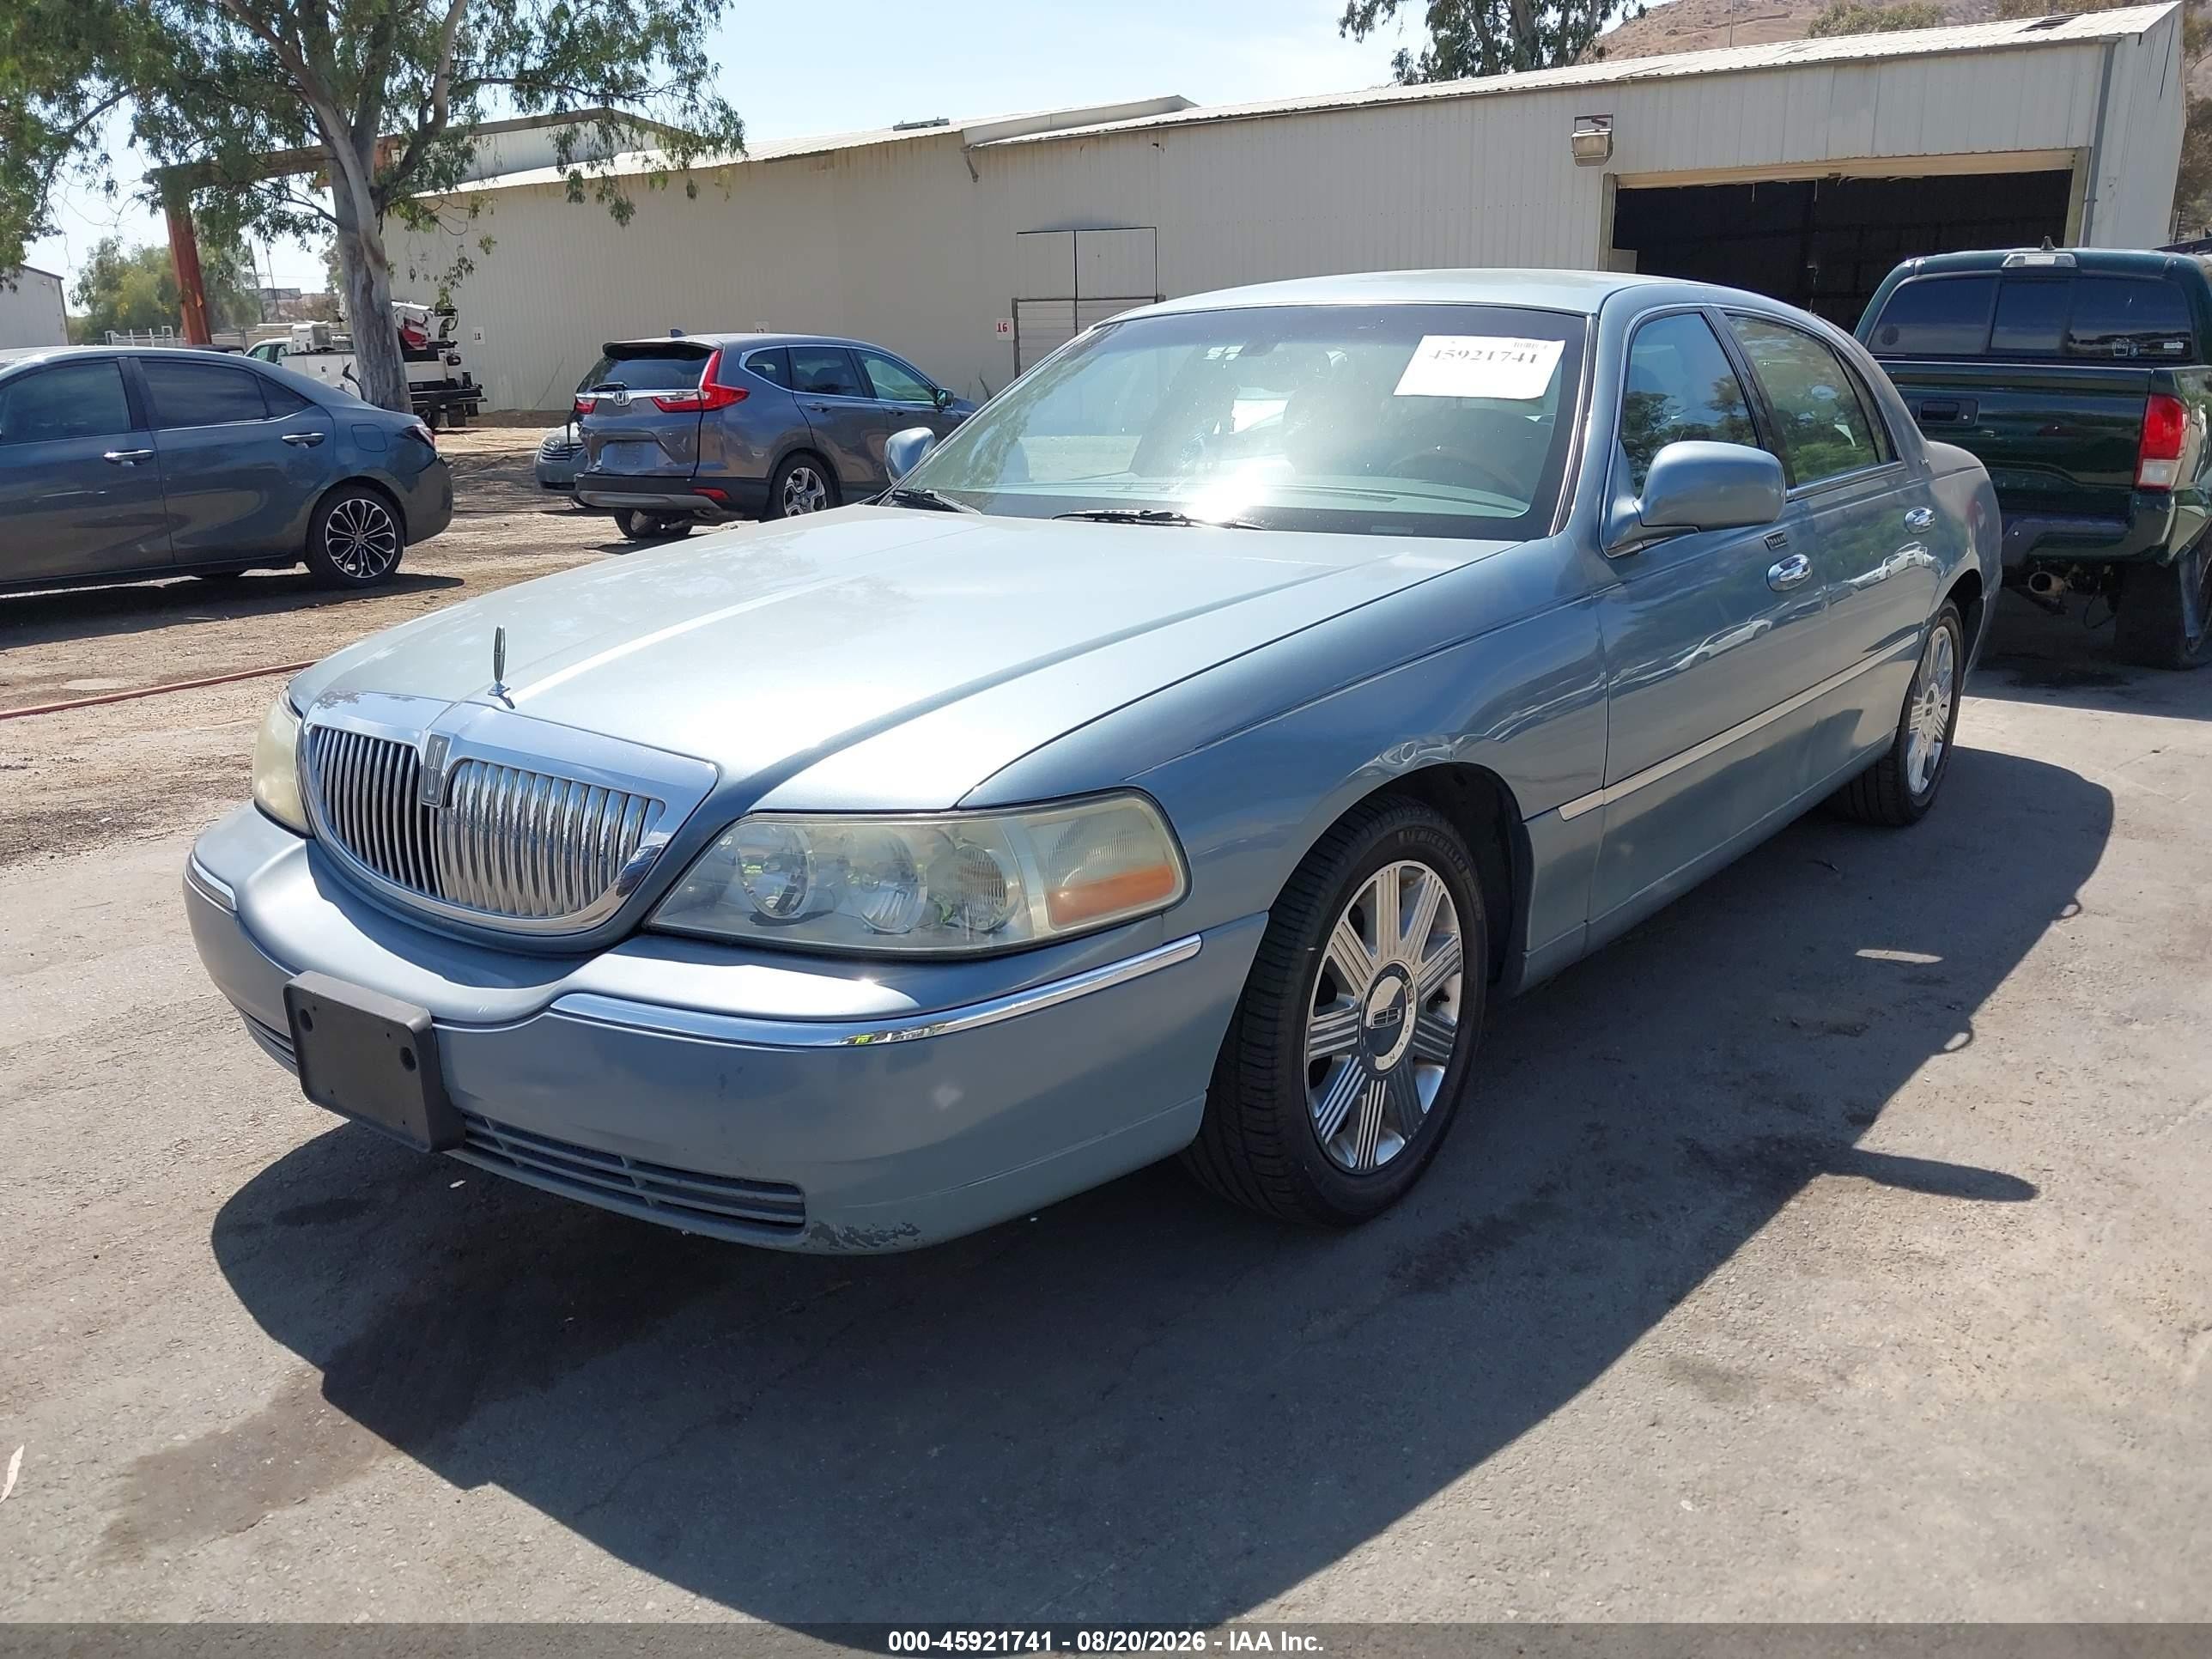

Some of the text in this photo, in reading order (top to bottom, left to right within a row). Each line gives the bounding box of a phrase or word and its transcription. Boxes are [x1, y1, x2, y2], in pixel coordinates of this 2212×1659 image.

[996, 322, 1007, 332] 16
[1429, 349, 1538, 364] 45921741
[1417, 830, 1466, 872] MICHELIN
[1389, 969, 1414, 1063] LINCOLN
